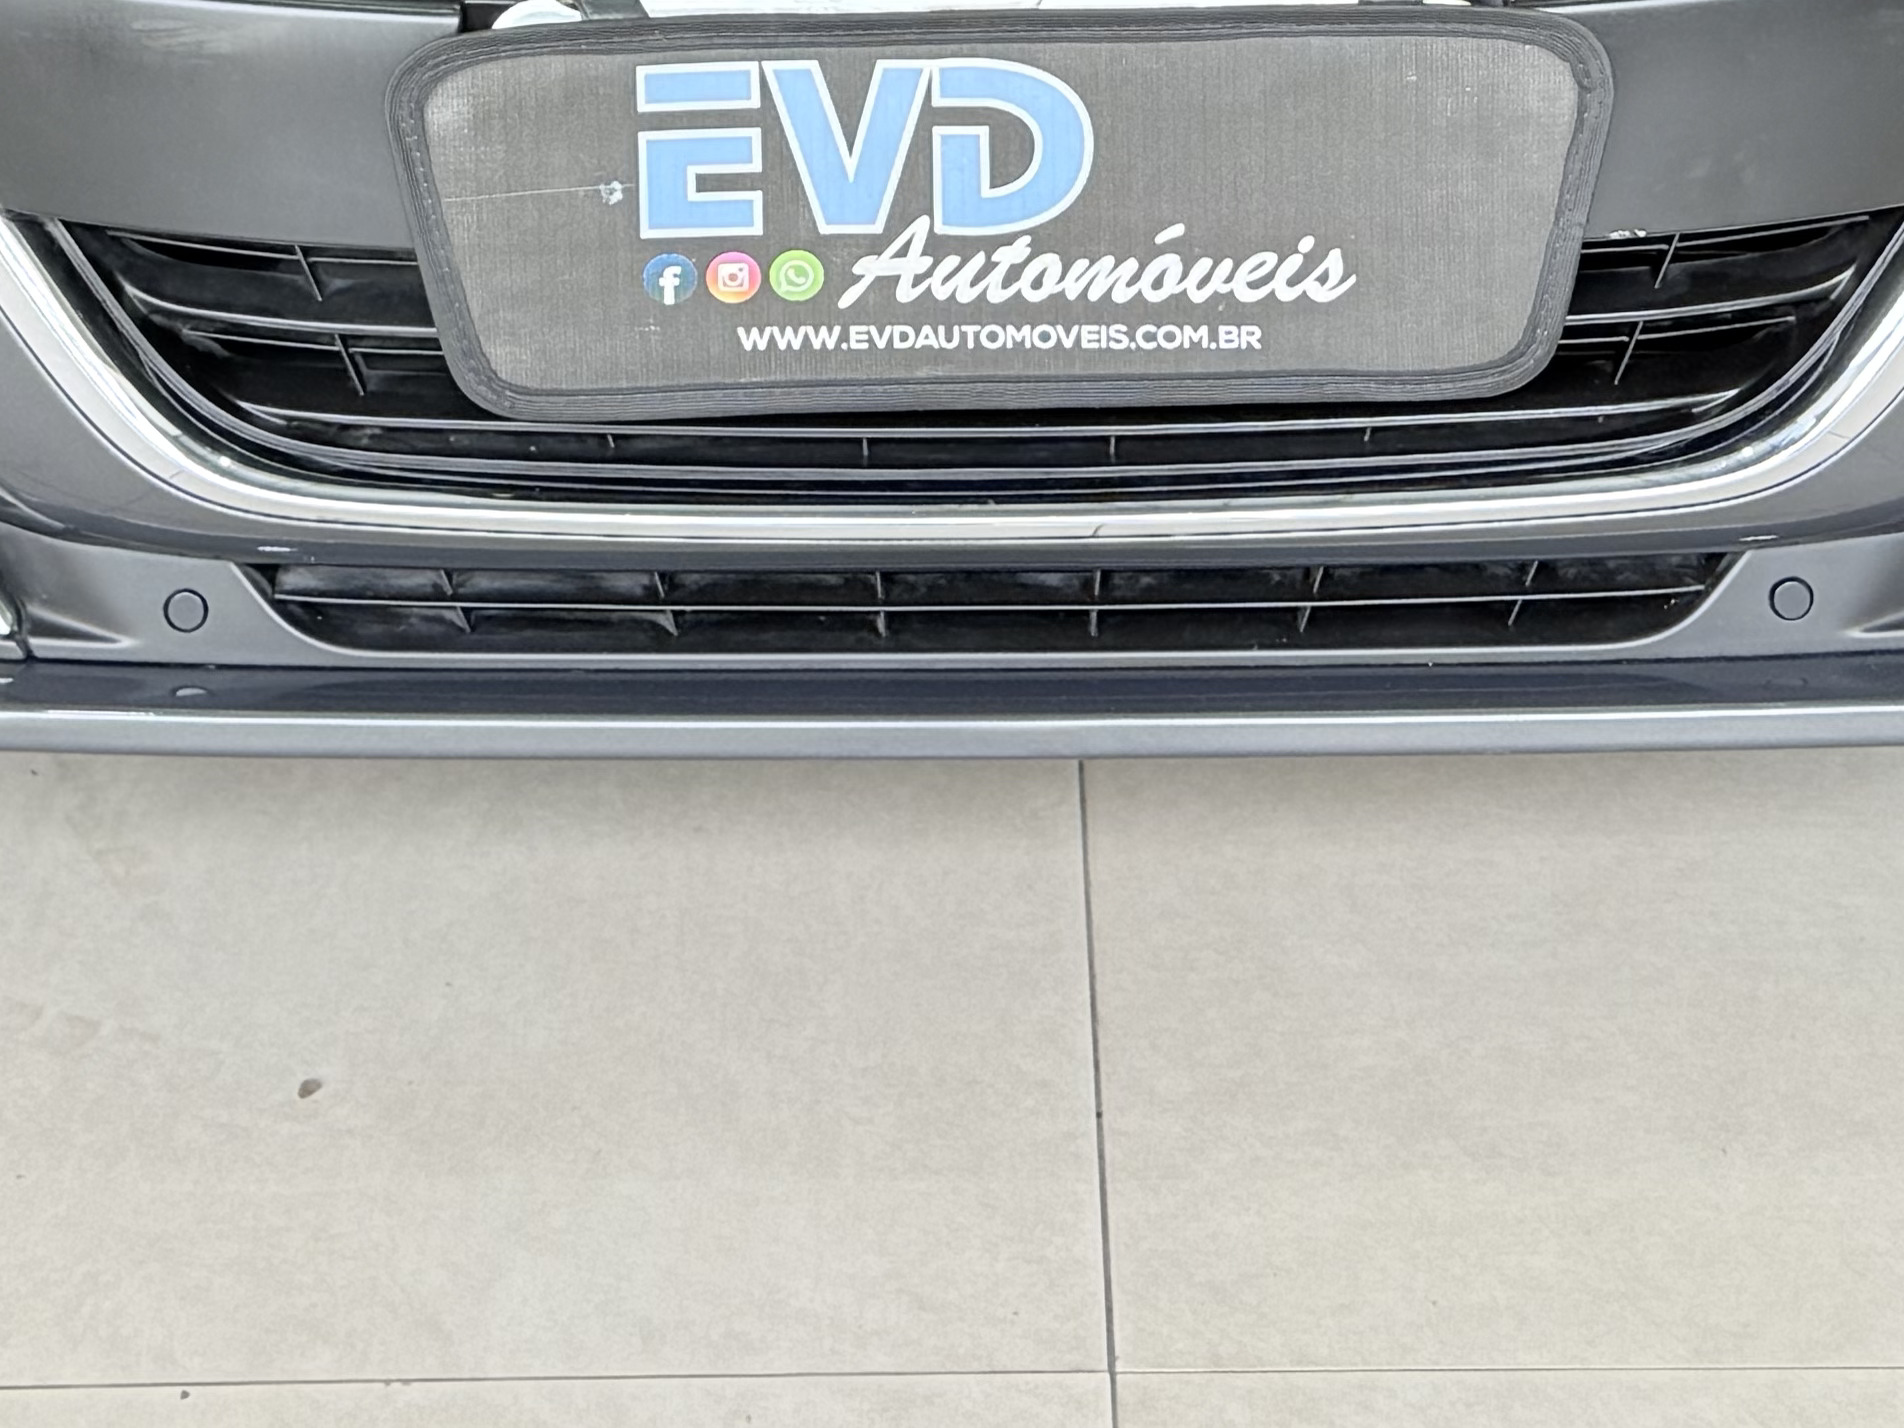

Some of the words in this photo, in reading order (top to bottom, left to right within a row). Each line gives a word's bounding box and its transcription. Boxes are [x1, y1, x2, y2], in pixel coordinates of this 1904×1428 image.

[636, 57, 1094, 238] EVD
[839, 216, 1356, 309] Automóveis
[736, 323, 1262, 351] WWW.EVDAUTOMOVEIS.COM.BR
